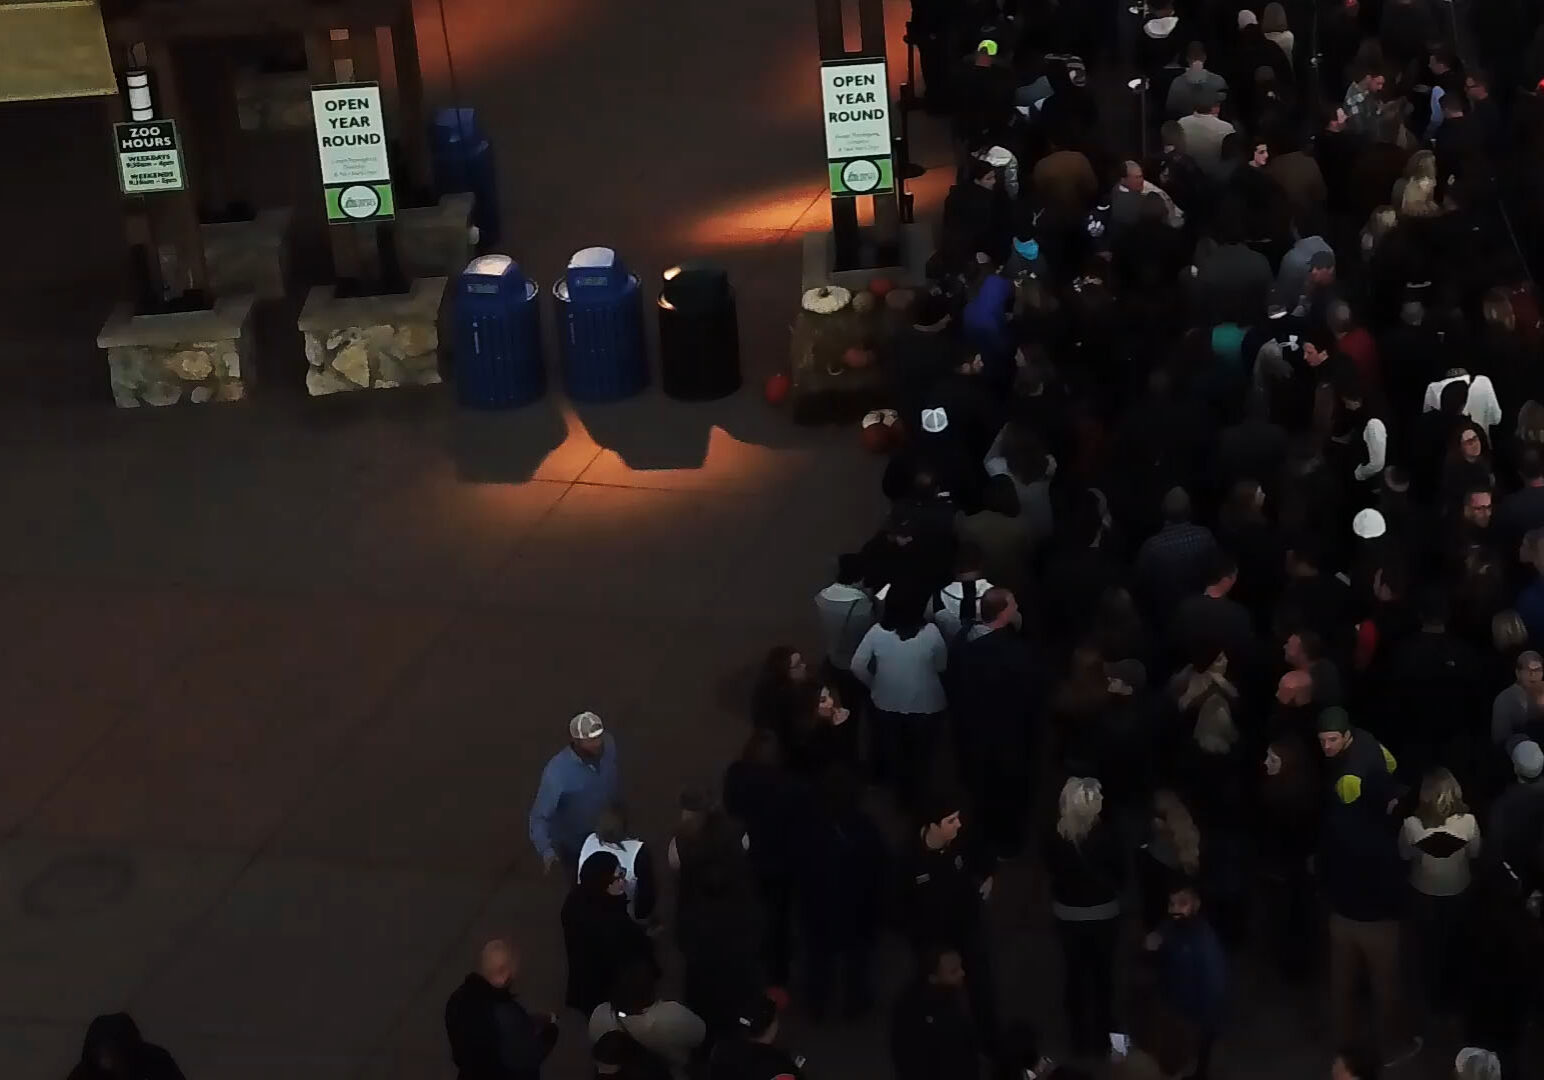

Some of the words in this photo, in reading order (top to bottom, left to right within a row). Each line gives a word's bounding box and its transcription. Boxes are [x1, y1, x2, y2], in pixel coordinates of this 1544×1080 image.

[833, 74, 875, 88] OPEN
[325, 98, 370, 112] OPEN
[836, 92, 876, 105] YEAR
[329, 115, 371, 129] YEAR
[828, 109, 885, 123] ROUND
[129, 126, 161, 138] ZOO
[122, 136, 172, 149] HOURS
[322, 133, 381, 148] ROUND
